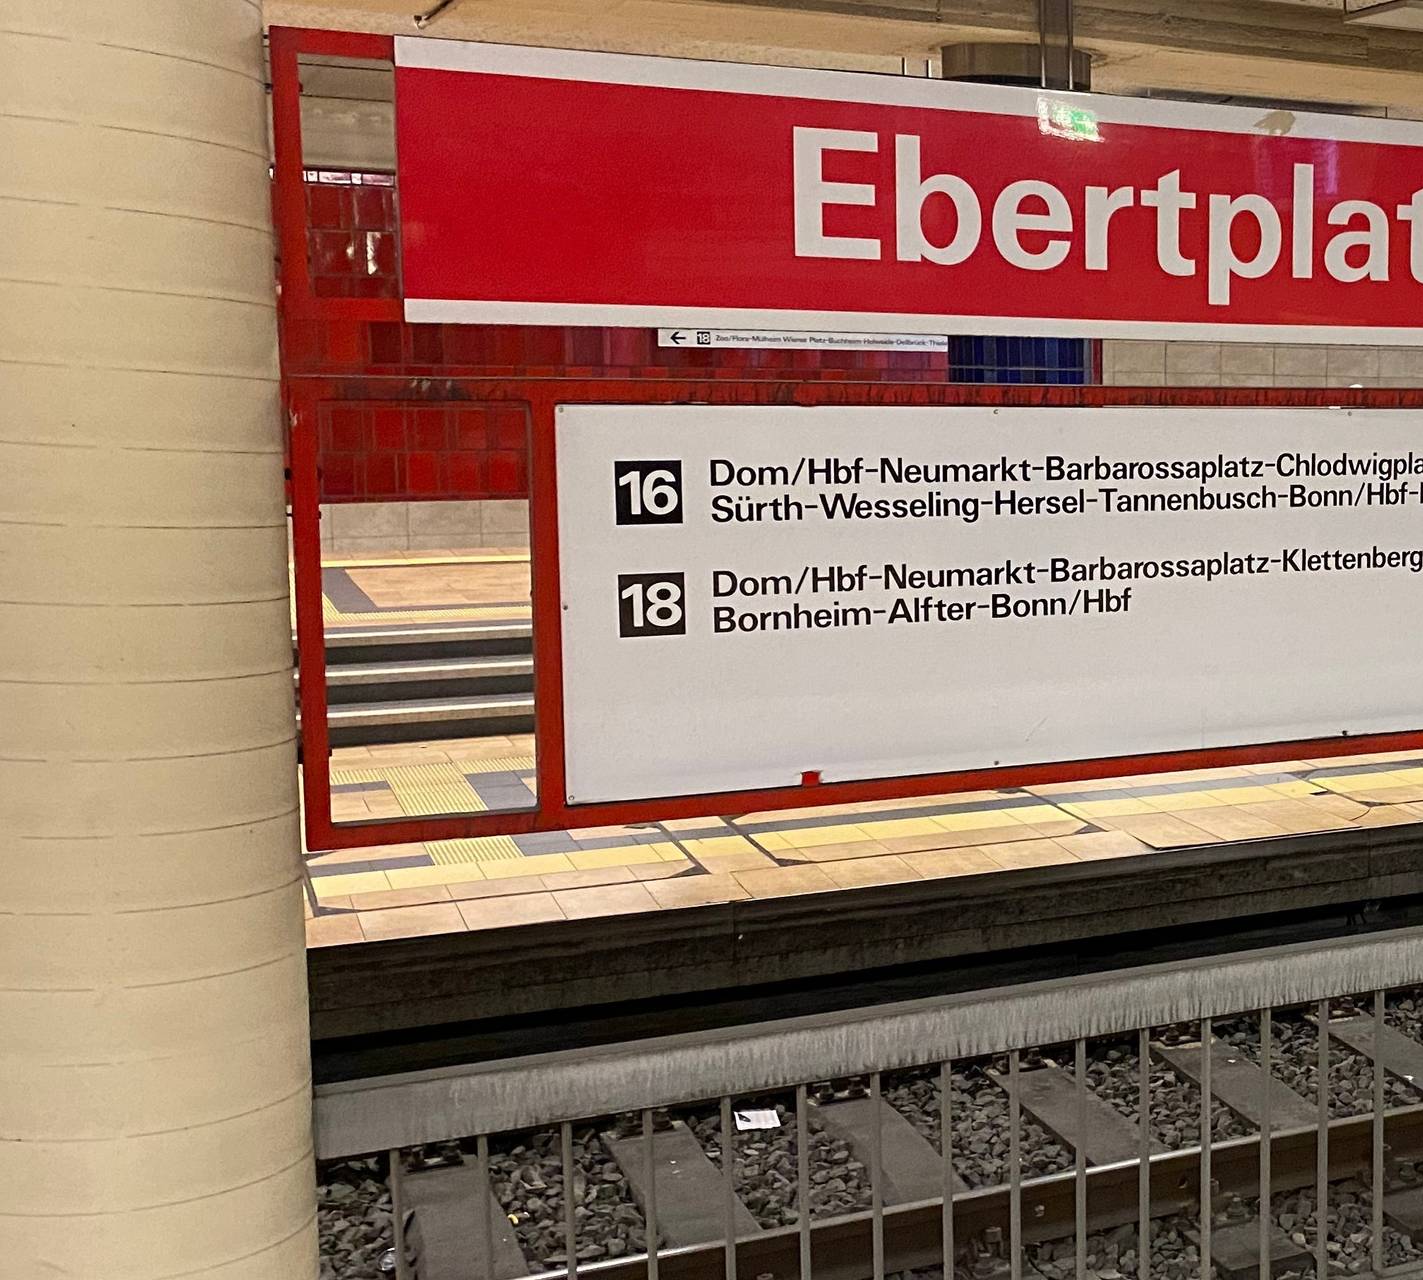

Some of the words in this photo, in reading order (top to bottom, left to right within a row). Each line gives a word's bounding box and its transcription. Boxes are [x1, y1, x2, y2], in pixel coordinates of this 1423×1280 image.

[697, 332, 710, 343] 18
[618, 469, 678, 514] 16
[621, 582, 682, 627] 18
[713, 588, 1132, 633] Bornheim-Alfter-Bonn/Hbf
